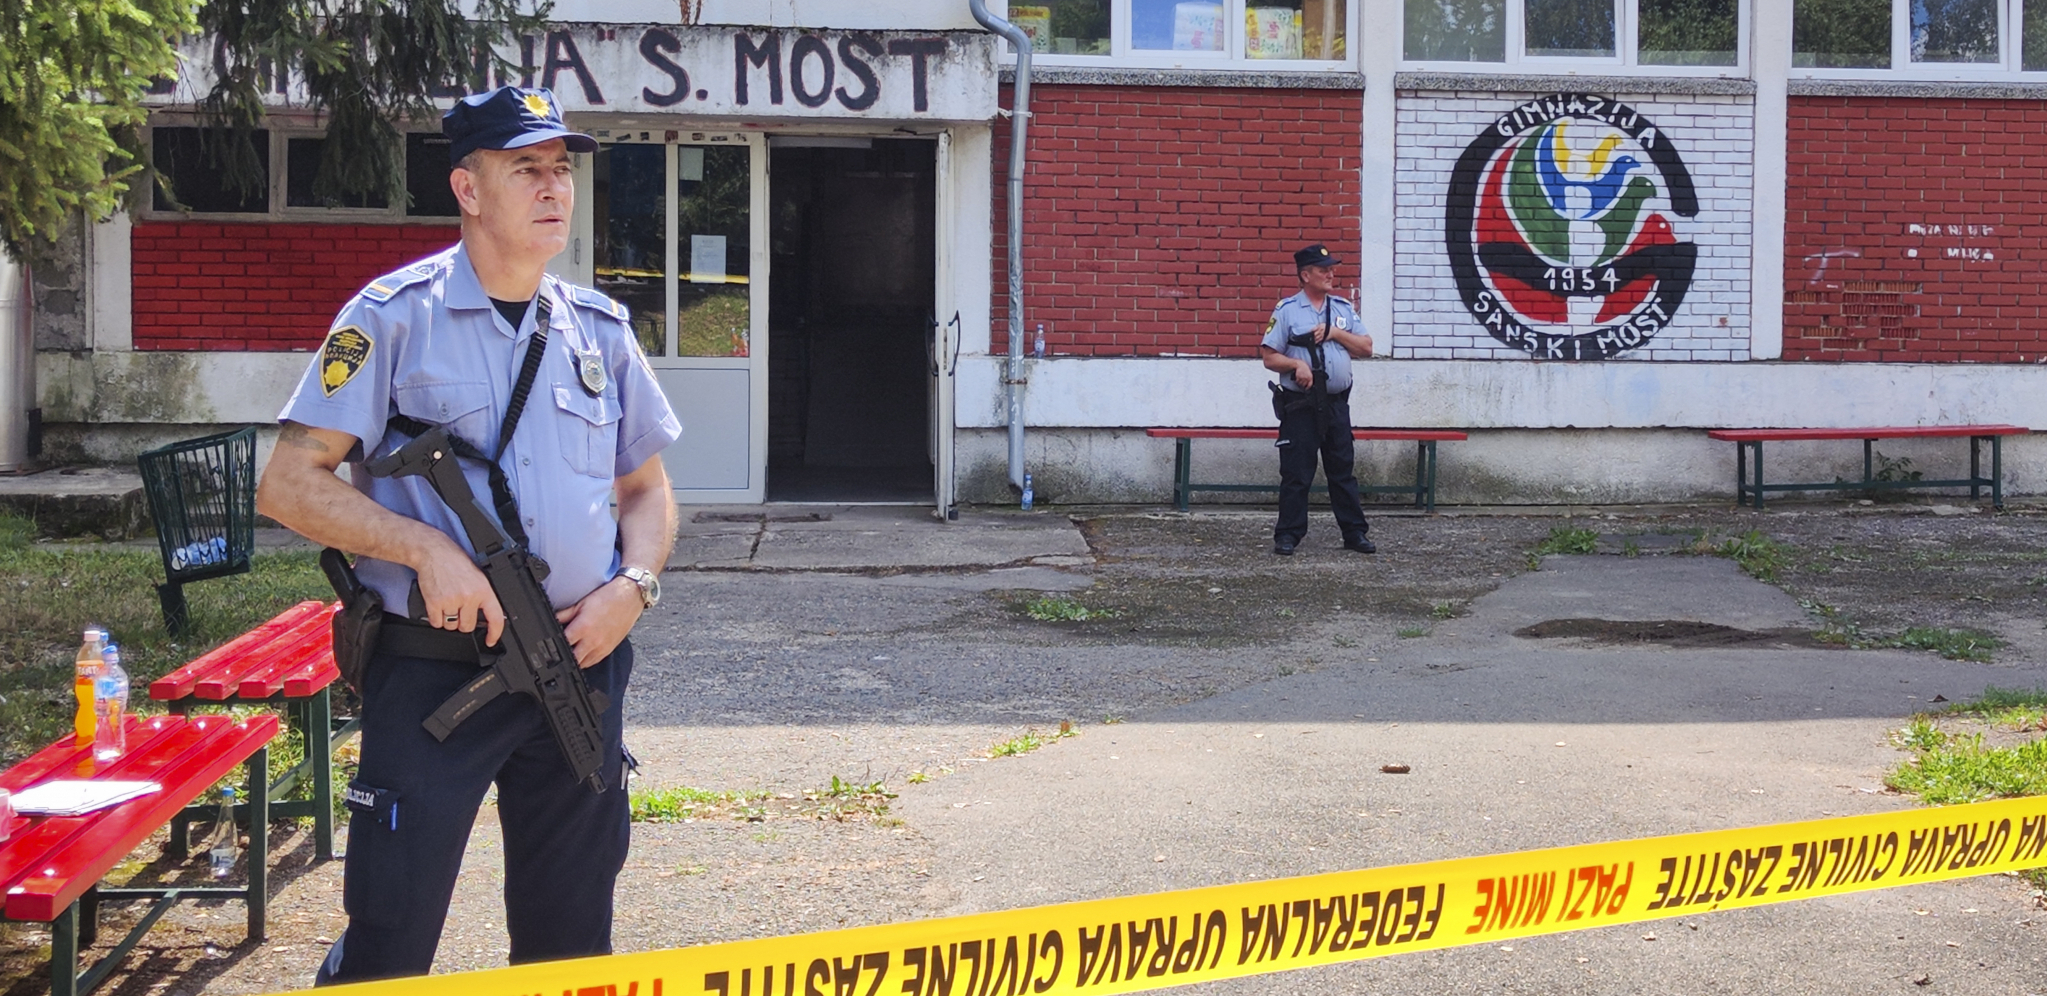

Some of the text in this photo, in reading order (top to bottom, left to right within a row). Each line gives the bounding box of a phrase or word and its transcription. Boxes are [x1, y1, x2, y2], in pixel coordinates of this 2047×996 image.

[734, 31, 949, 112] MOST
[1496, 94, 1657, 148] GIMNAZIJA
[1543, 268, 1621, 293] 1954
[1473, 292, 1669, 360] SANSKI MOST
[1776, 831, 1899, 893] CIVILNE
[1899, 818, 2011, 877] UPRAVA
[1237, 883, 1445, 966] FEDERALNA
[1465, 871, 1556, 935] MINE
[1076, 909, 1227, 988] UPRAVA
